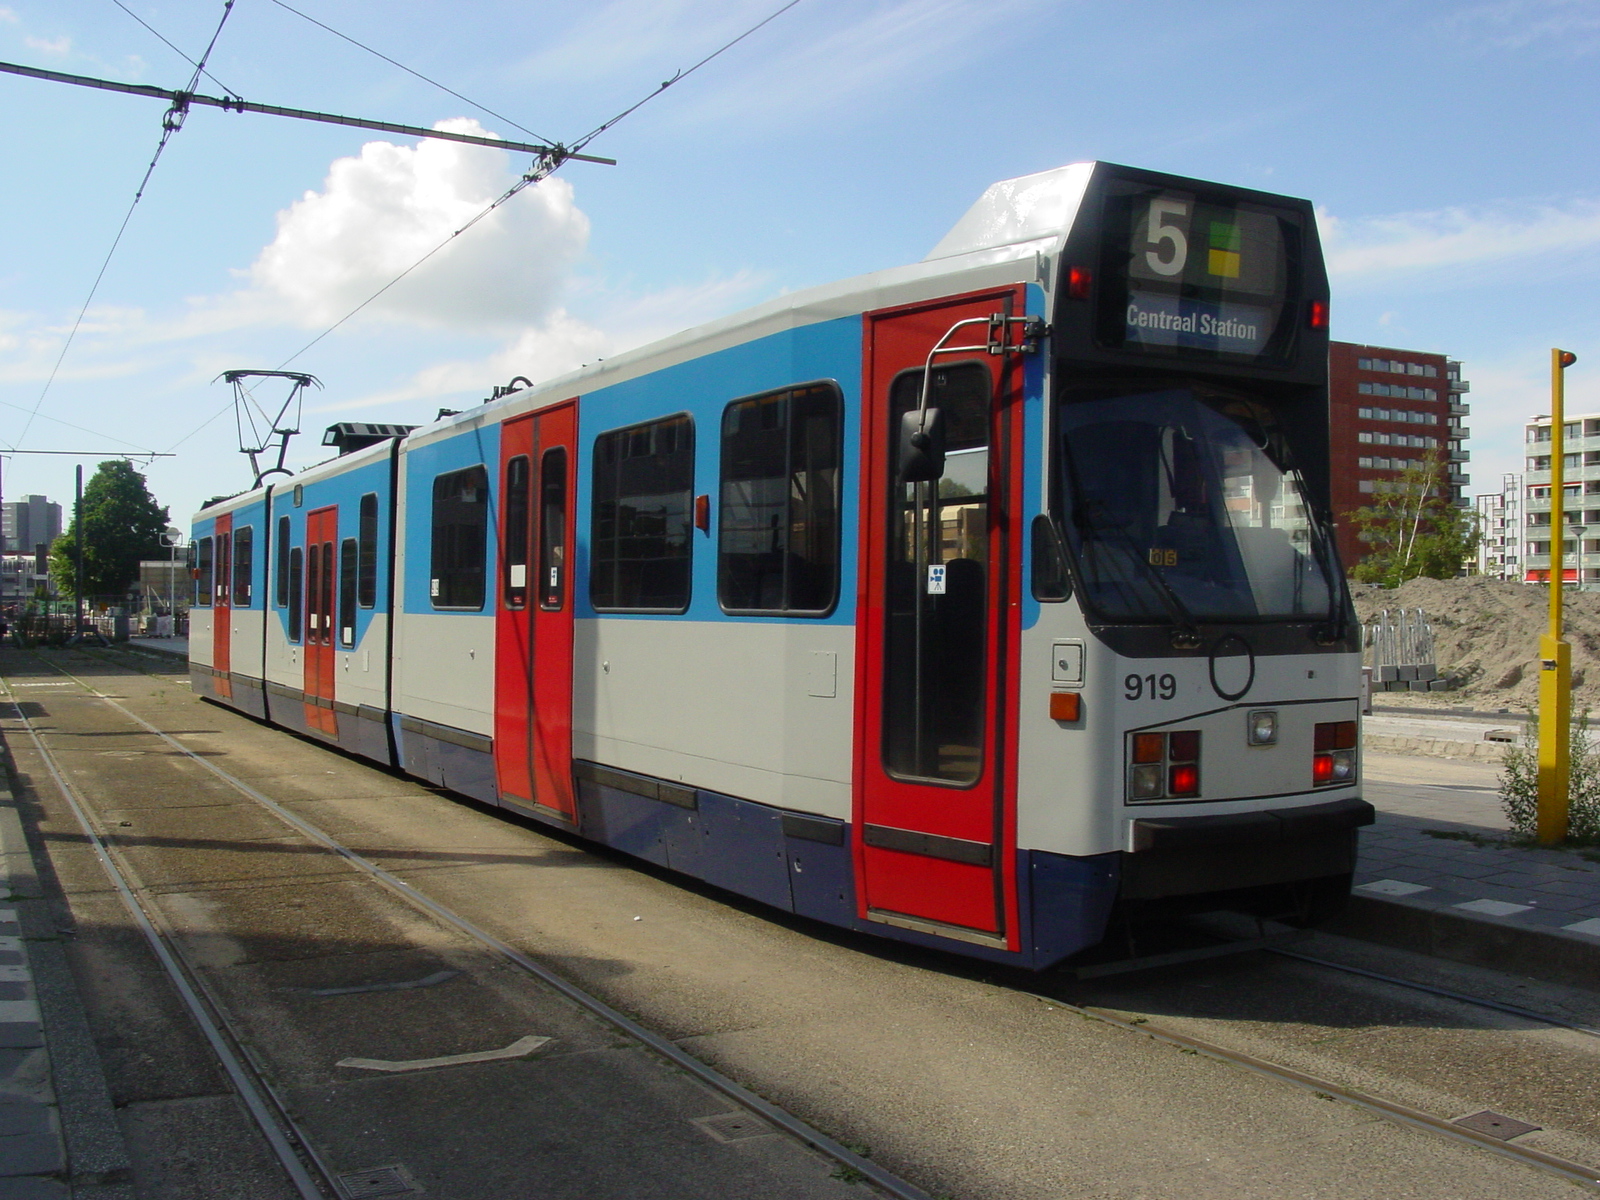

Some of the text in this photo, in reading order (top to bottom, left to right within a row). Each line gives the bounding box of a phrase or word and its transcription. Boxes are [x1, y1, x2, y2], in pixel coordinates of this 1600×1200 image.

[1145, 198, 1188, 276] 5
[1126, 304, 1257, 341] Centraal Station
[1124, 673, 1177, 701] 919
